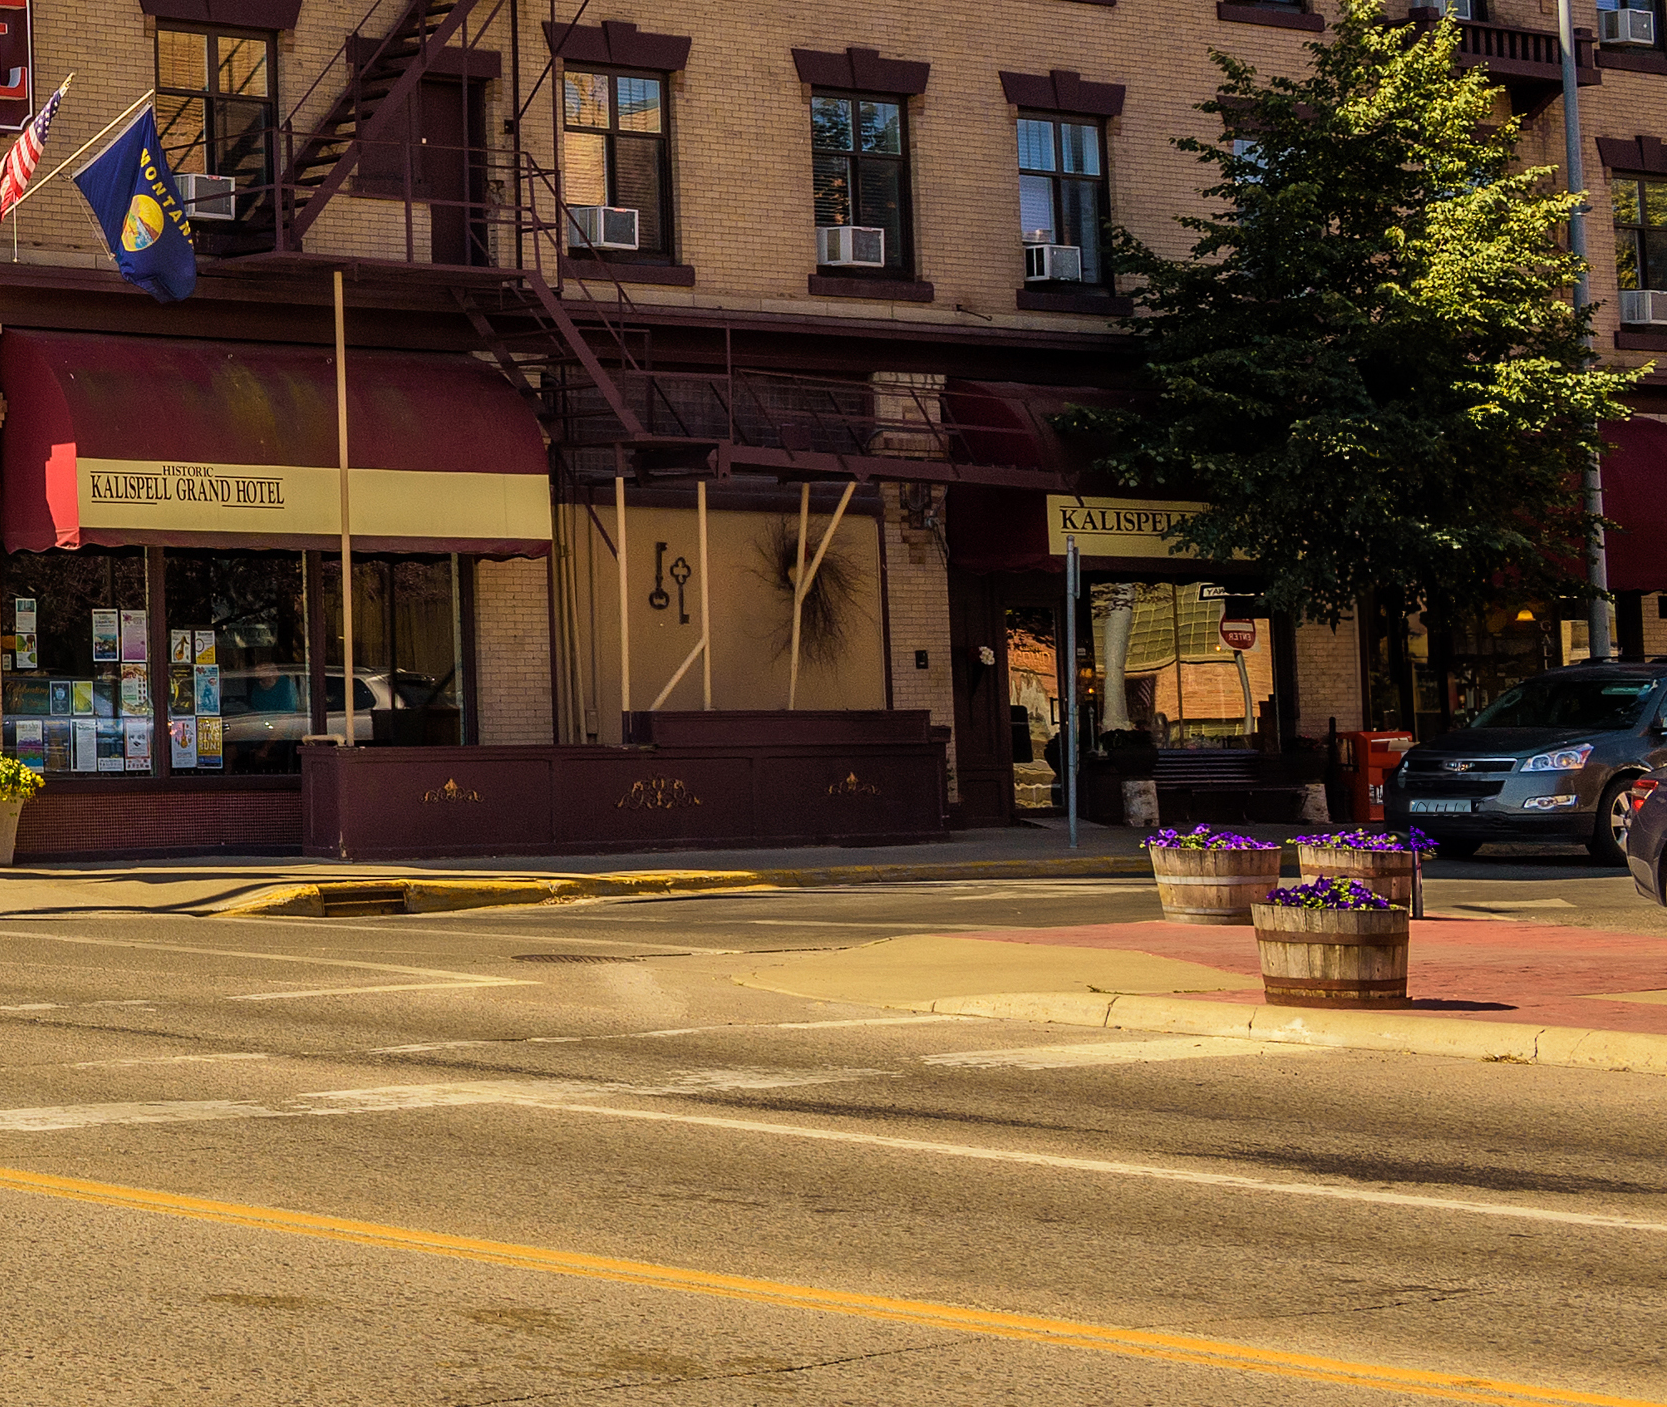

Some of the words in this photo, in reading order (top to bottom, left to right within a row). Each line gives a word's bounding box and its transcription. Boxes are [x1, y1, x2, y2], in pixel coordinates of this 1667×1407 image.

[140, 148, 193, 244] MONTAN
[162, 465, 214, 478] HISTORIC
[90, 475, 172, 501] KALISPELL
[176, 478, 231, 503] GRAND
[235, 480, 285, 505] HOTEL
[198, 732, 220, 741] BIKE
[198, 741, 220, 751] RUN!
